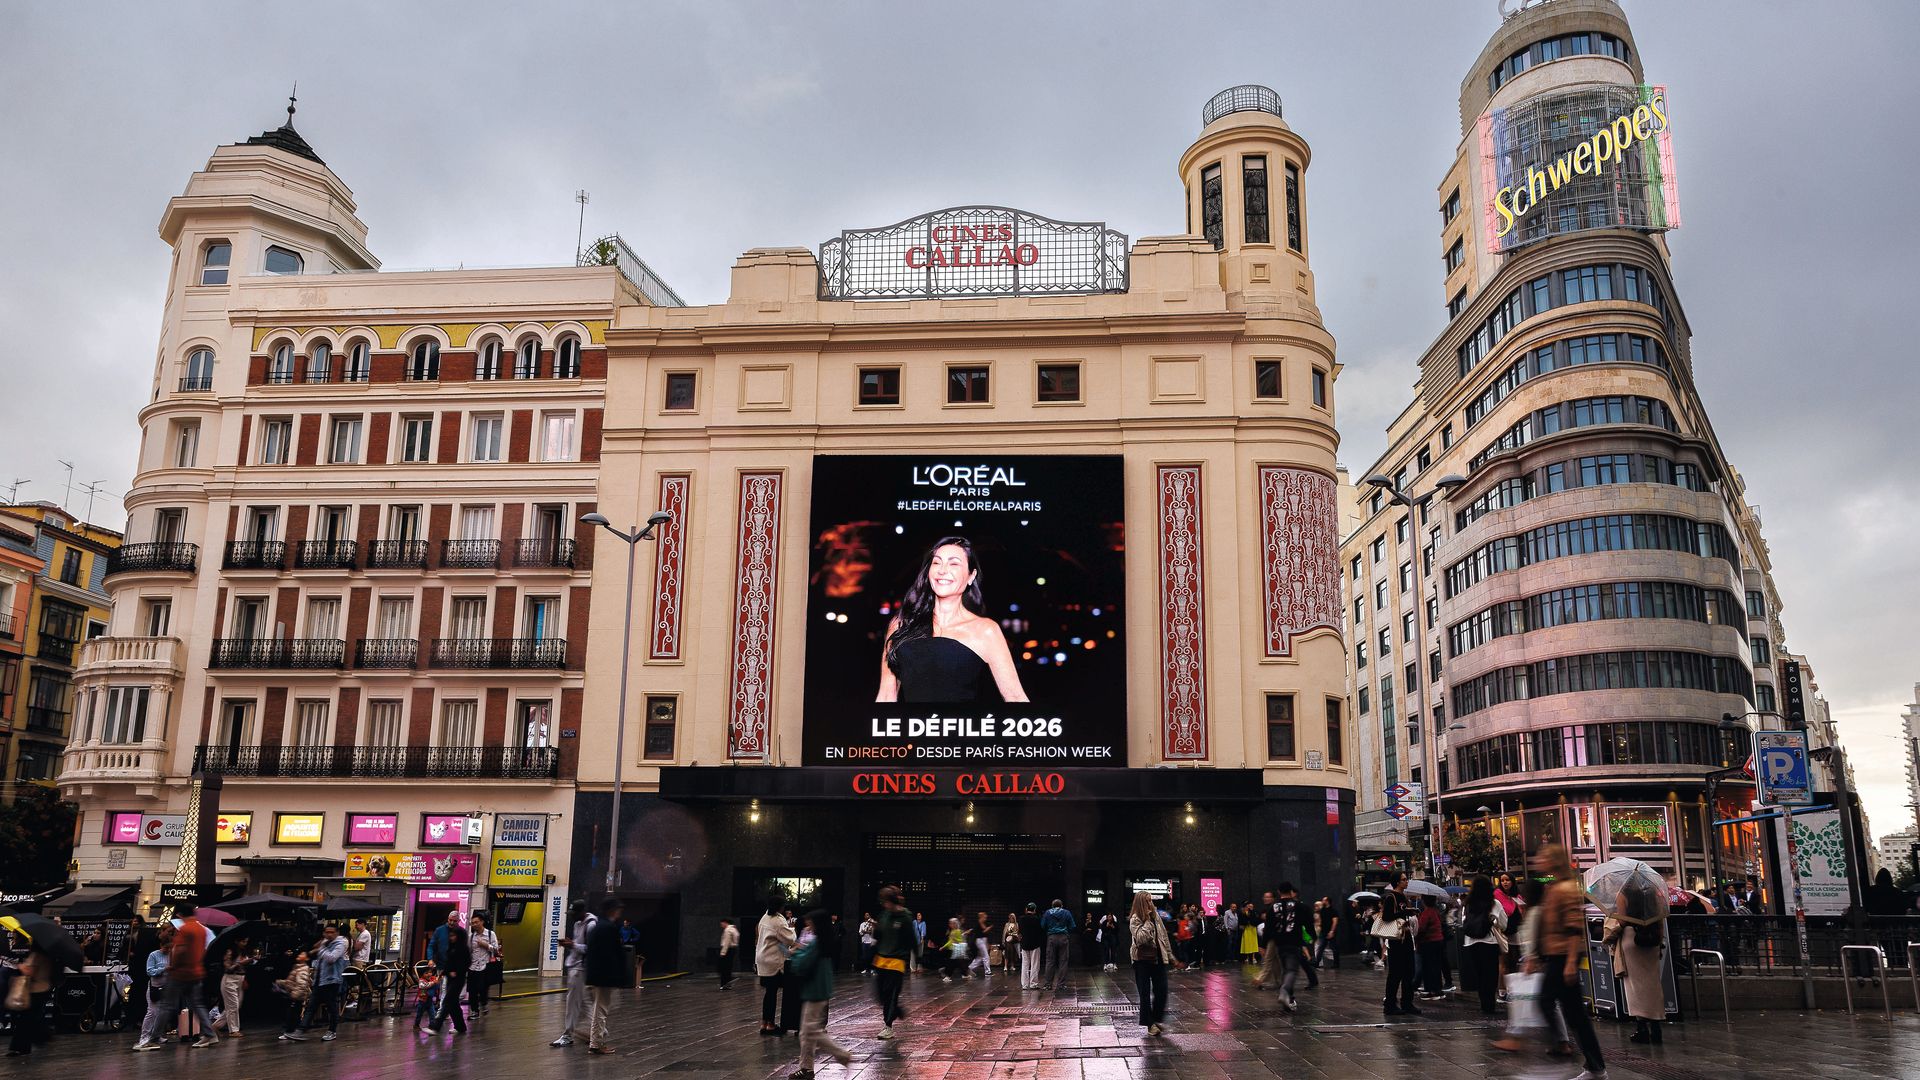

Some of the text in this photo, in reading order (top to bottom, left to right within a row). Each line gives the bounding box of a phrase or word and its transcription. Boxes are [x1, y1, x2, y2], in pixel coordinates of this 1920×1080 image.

[1494, 95, 1667, 238] Schweppes
[932, 224, 1012, 243] CINES
[905, 243, 1039, 269] CALLAO
[913, 464, 1026, 486] L'ORÉAL
[949, 488, 990, 497] PARIS
[897, 500, 1042, 511] #LEDÉFILÉLOREALPARIS
[1789, 666, 1800, 704] ROOM
[872, 714, 1063, 737] LE DÉFILÉ 2026
[825, 744, 1112, 758] EN DIRECTO DESDE PARÍS FASHION WEEK
[852, 773, 1065, 795] CINES CALLAO
[502, 819, 540, 830] CAMBIO
[501, 830, 539, 842] CHANGE
[497, 859, 538, 867] CAMBIO
[496, 868, 538, 876] CHANGE
[164, 889, 198, 897] L'ORÉAL
[549, 896, 562, 961] CAMBIO CHANGE
